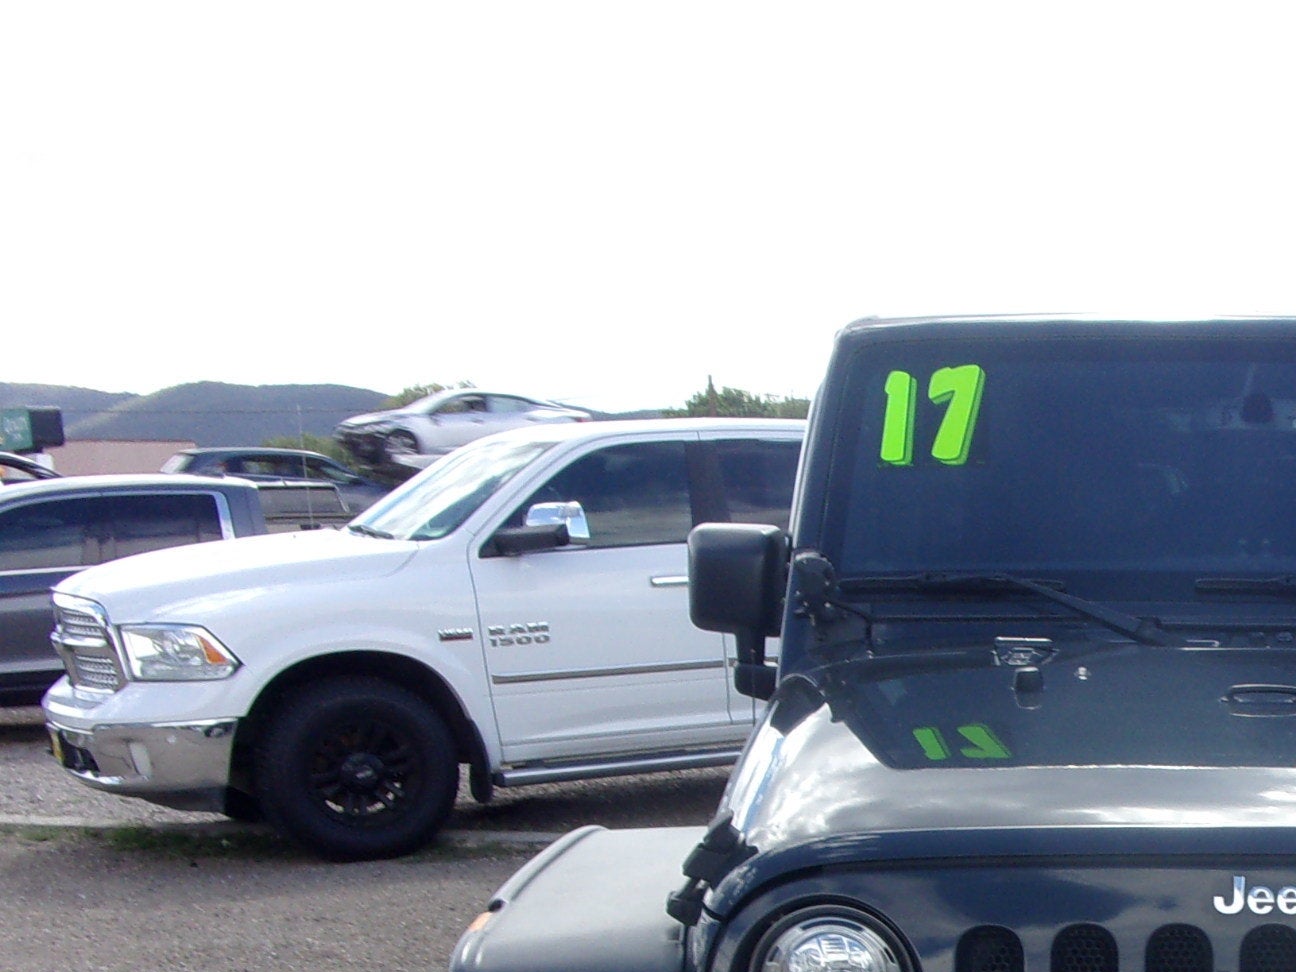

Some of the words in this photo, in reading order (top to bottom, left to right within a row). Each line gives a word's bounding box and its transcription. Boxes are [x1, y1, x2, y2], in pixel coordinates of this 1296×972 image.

[880, 364, 986, 465] 17
[487, 621, 549, 636] RAM
[488, 633, 550, 648] 1500
